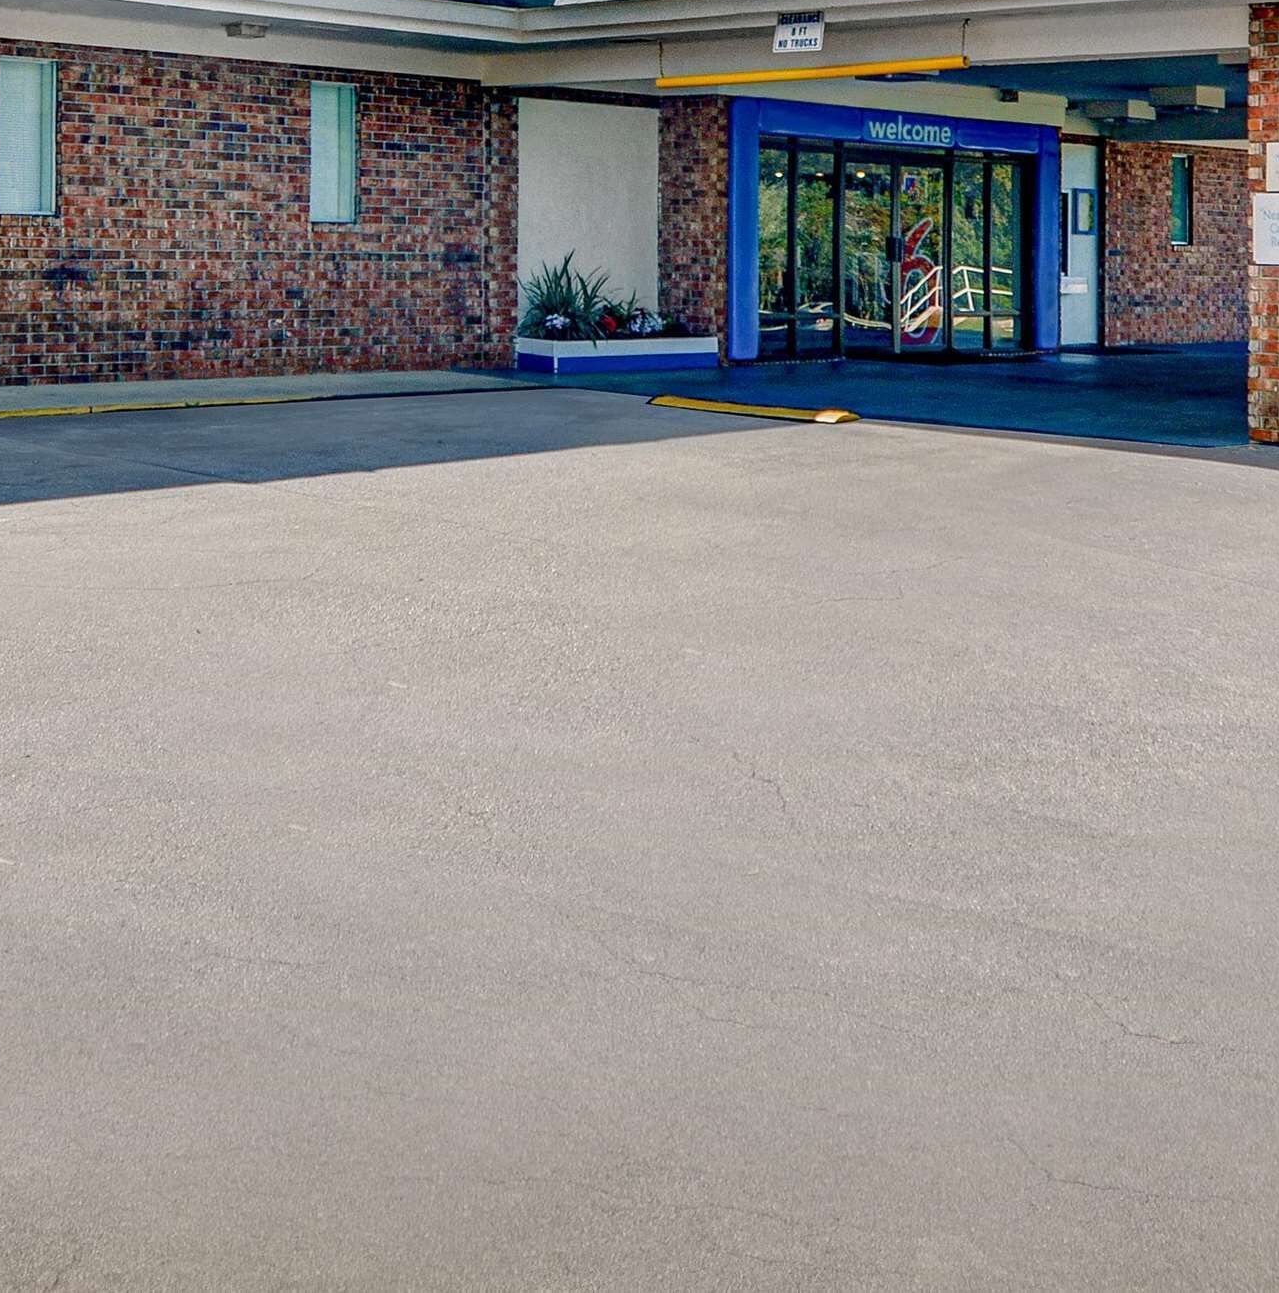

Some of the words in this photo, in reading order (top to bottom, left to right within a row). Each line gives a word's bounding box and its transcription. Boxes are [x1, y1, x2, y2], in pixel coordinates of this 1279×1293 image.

[799, 26, 808, 36] FT
[778, 39, 788, 48] NO
[791, 38, 818, 47] TRUCKS
[868, 115, 951, 143] welcome
